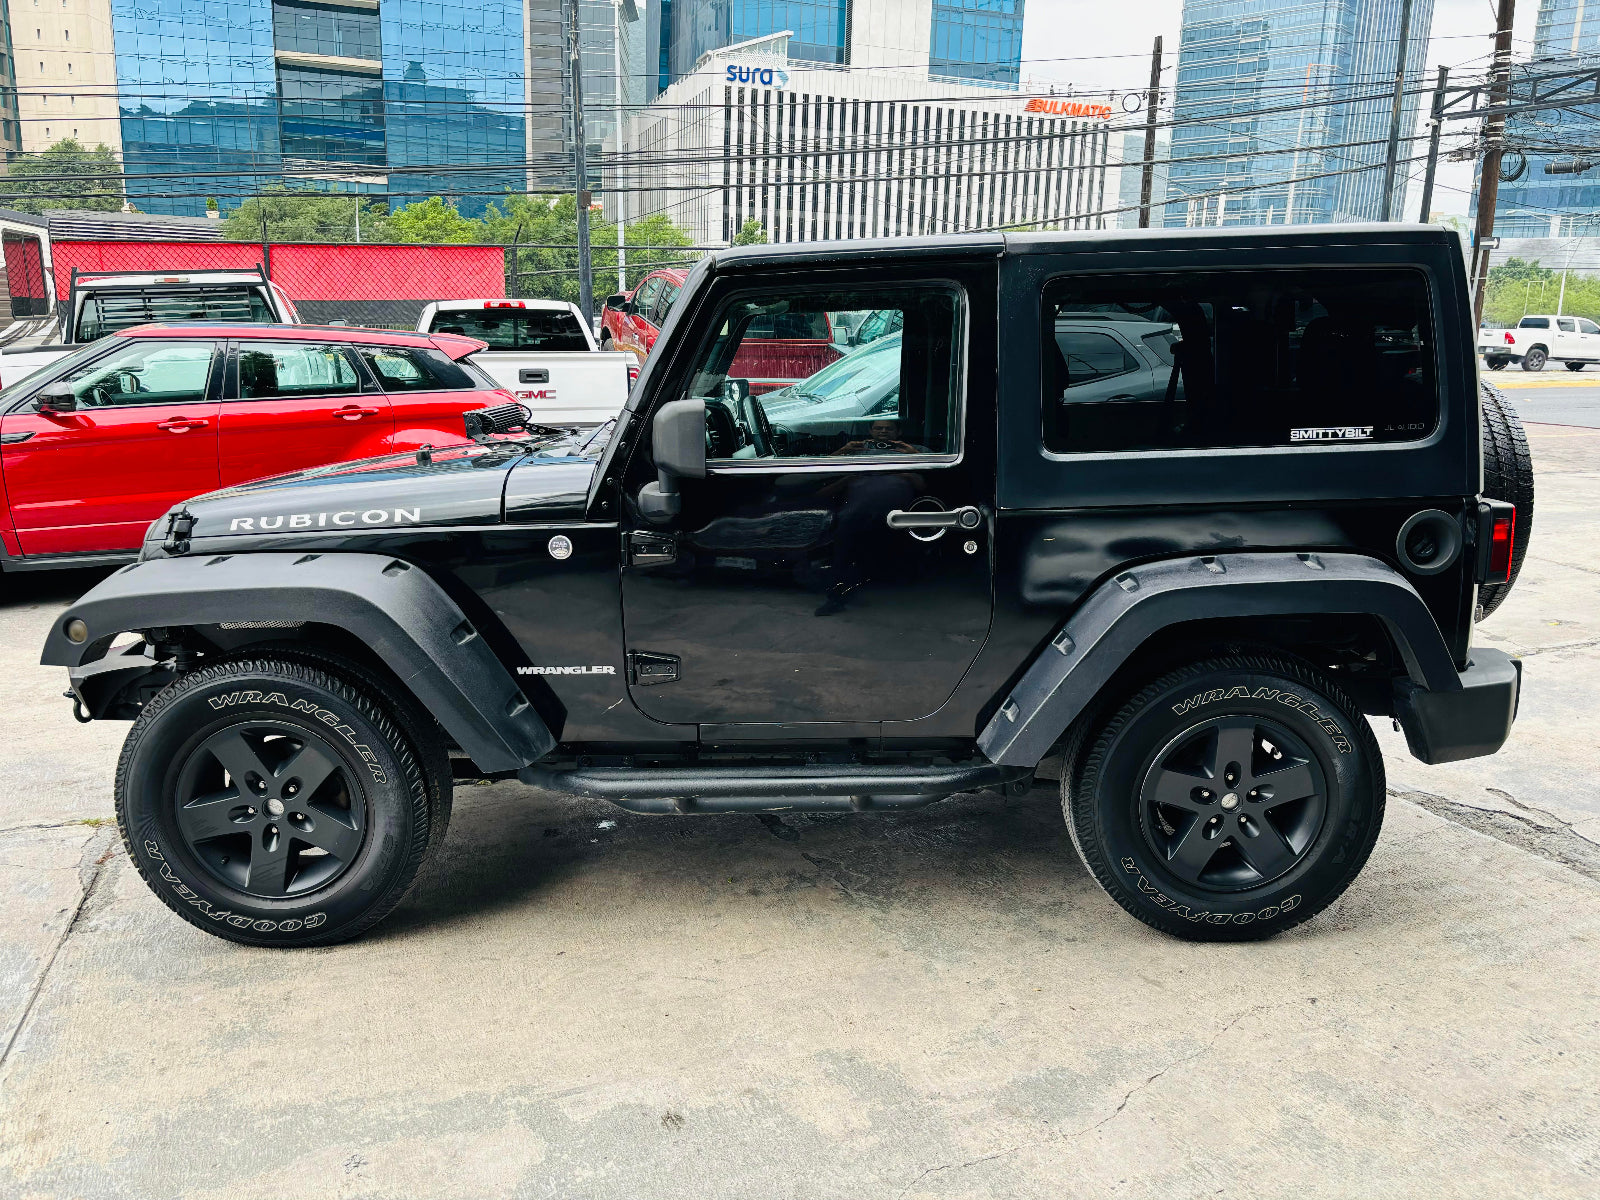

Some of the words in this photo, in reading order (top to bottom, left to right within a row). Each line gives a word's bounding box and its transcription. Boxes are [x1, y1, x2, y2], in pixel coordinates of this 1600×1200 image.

[727, 64, 773, 86] sura
[1025, 98, 1112, 120] BULKMATIC
[515, 389, 556, 400] GMC
[1290, 426, 1374, 441] SMITTYBILT
[229, 507, 421, 531] RUBICON
[516, 665, 616, 675] WRANGLER
[1172, 685, 1352, 755] WRANGLER
[208, 690, 387, 785] WRANGLER
[144, 839, 327, 932] GOODYEAR
[1121, 856, 1302, 925] GOODYEAR
